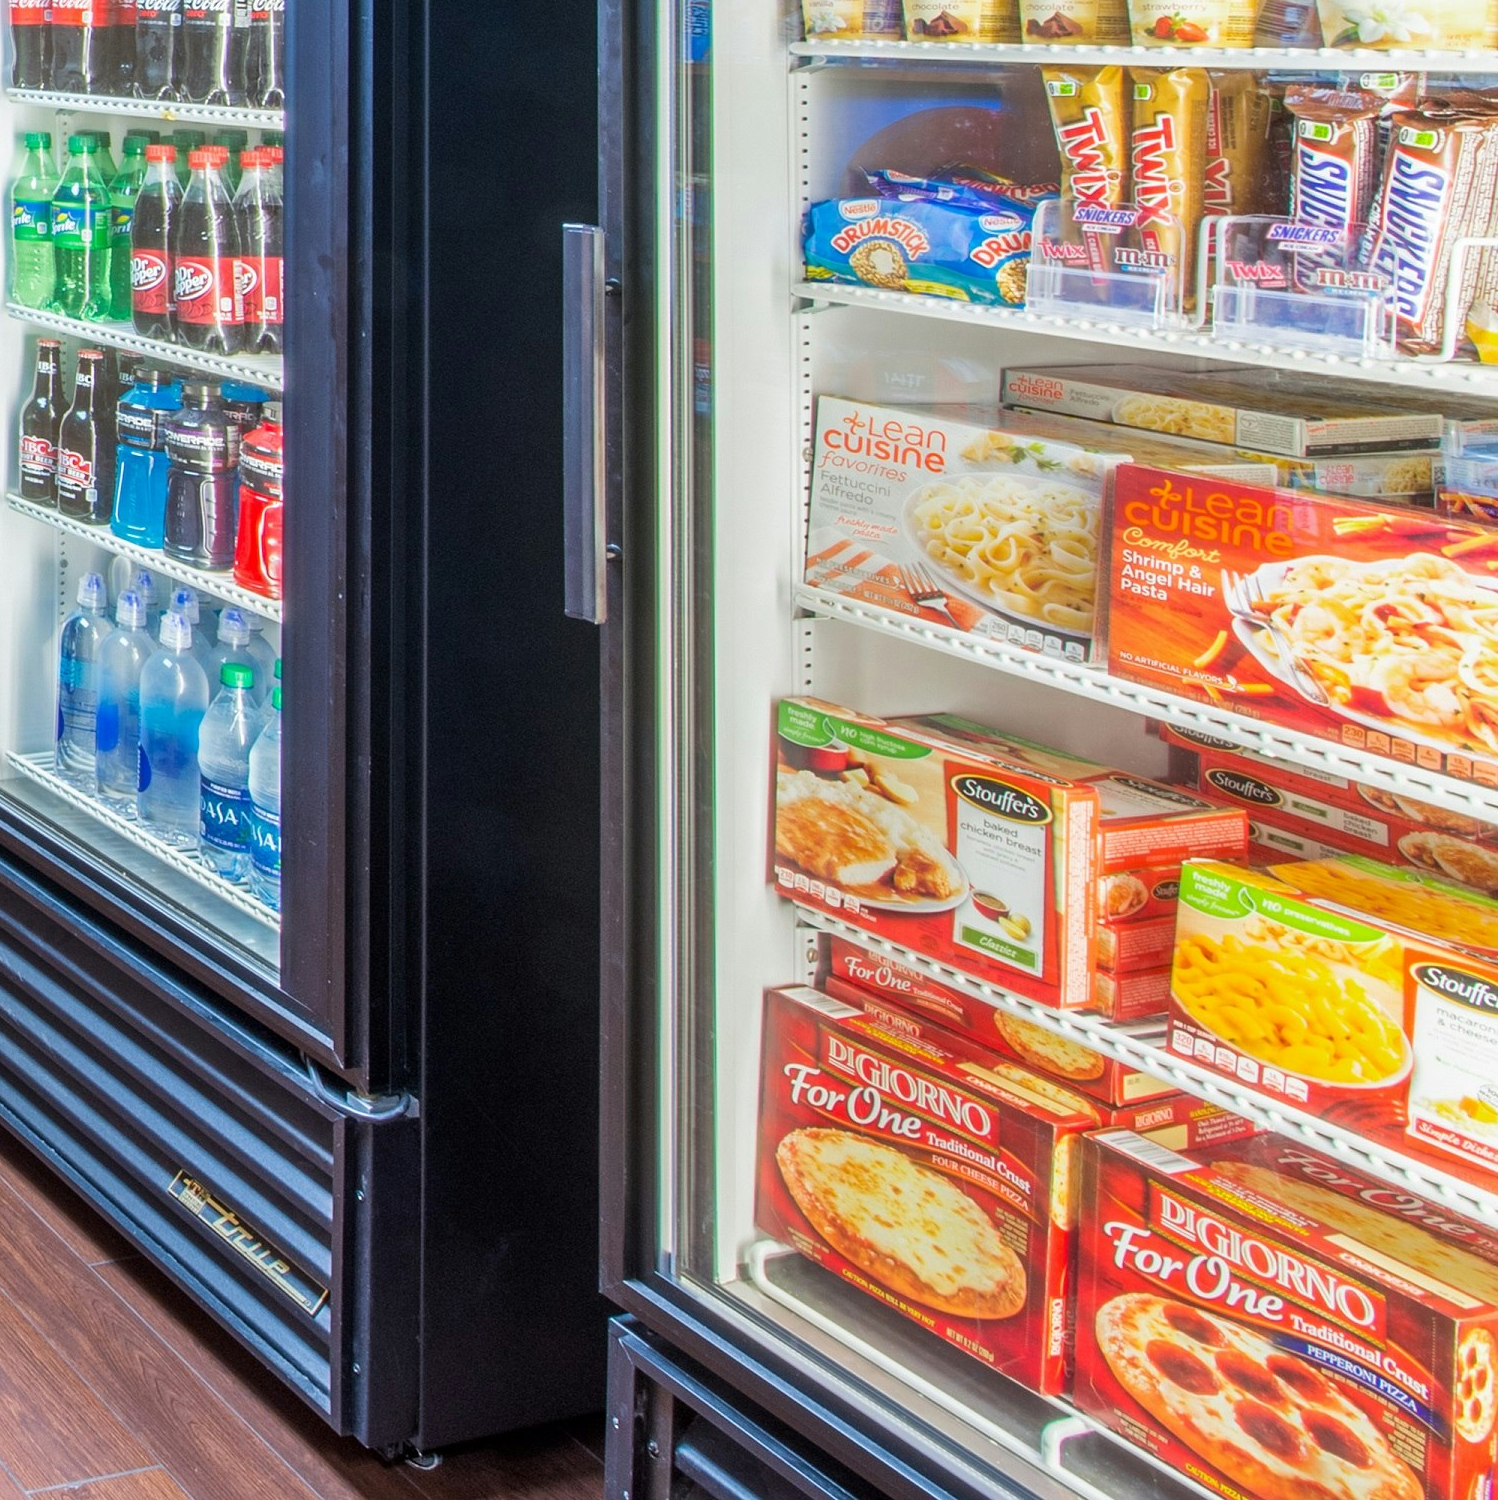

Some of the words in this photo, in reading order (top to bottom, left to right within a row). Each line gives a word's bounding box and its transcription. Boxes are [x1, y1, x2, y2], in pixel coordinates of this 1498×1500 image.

[808, 0, 834, 8] vanilla
[911, 2, 959, 10] chocolate
[1026, 3, 1074, 11] chocolate
[1142, 2, 1207, 12] strawberry
[1075, 208, 1137, 225] SNICKERS
[831, 218, 930, 261] DRUMSTICK
[1270, 225, 1340, 243] SNICKERS
[1038, 242, 1086, 259] Twix
[1226, 260, 1284, 280] Twix
[38, 361, 57, 372] IBC
[1029, 377, 1063, 390] Lean
[870, 416, 946, 452] Lean
[24, 441, 46, 454] IBC
[35, 455, 53, 464] BEER
[818, 450, 908, 483] favorites
[67, 468, 86, 479] BEER
[821, 470, 891, 497] Fettuccini
[821, 484, 873, 505] Alfredo
[1186, 487, 1293, 532] Lean
[835, 515, 870, 530] freshly
[871, 523, 898, 533] made
[852, 528, 881, 539] pasta
[1123, 526, 1221, 563] Comfort
[1122, 549, 1184, 575] Shrimp
[1189, 566, 1202, 579] &
[1121, 565, 1172, 588] Angel
[1178, 579, 1215, 598] Hair
[1121, 578, 1168, 601] Pasta
[1119, 650, 1133, 661] NO
[1134, 654, 1181, 674] ARTIFICIAL
[1183, 667, 1224, 686] FLAVORS
[788, 707, 817, 722] freshly
[789, 716, 815, 729] made
[840, 725, 858, 738] no
[1343, 725, 1363, 739] 230
[963, 778, 1039, 819] Stouffer's
[1214, 773, 1274, 802] Stouffer's
[983, 819, 1018, 838] baked
[1343, 812, 1371, 826] baked
[1344, 819, 1378, 835] chicken
[960, 822, 1003, 844] chicken
[1006, 838, 1041, 857] breast
[1344, 826, 1372, 839] breast
[1192, 871, 1232, 893] freshly
[1193, 884, 1228, 901] made
[1262, 899, 1281, 913] no
[1284, 907, 1351, 937] preservatives
[979, 936, 1017, 958] Classics
[844, 956, 874, 979] For
[875, 967, 912, 992] One
[864, 1002, 920, 1037] DIGIORNO
[1175, 1032, 1192, 1046] 320
[1450, 1022, 1498, 1045] cheese
[827, 1036, 992, 1137] DIGIORNO
[783, 1063, 845, 1111] For
[847, 1085, 921, 1139] One
[1135, 1107, 1173, 1127] DIGIORNO
[1419, 1122, 1461, 1146] Simple
[926, 1132, 995, 1172] Traditional
[995, 1159, 1032, 1194] Crust
[932, 1154, 959, 1173] FOUR
[960, 1164, 1000, 1189] CHEESE
[1000, 1183, 1030, 1212] PIZZA
[1277, 1147, 1365, 1191] For
[1361, 1188, 1477, 1239] One
[1104, 1220, 1183, 1270] For
[1185, 1255, 1284, 1321] One
[1159, 1193, 1376, 1330] DIGIORNO
[868, 1282, 886, 1298] PIZZA
[1051, 1298, 1063, 1356] DIGIORNO
[1291, 1314, 1381, 1367] Traditional
[1382, 1355, 1430, 1400] Crust
[1307, 1344, 1378, 1384] PEPPERONI
[1379, 1379, 1419, 1413] PIZZA
